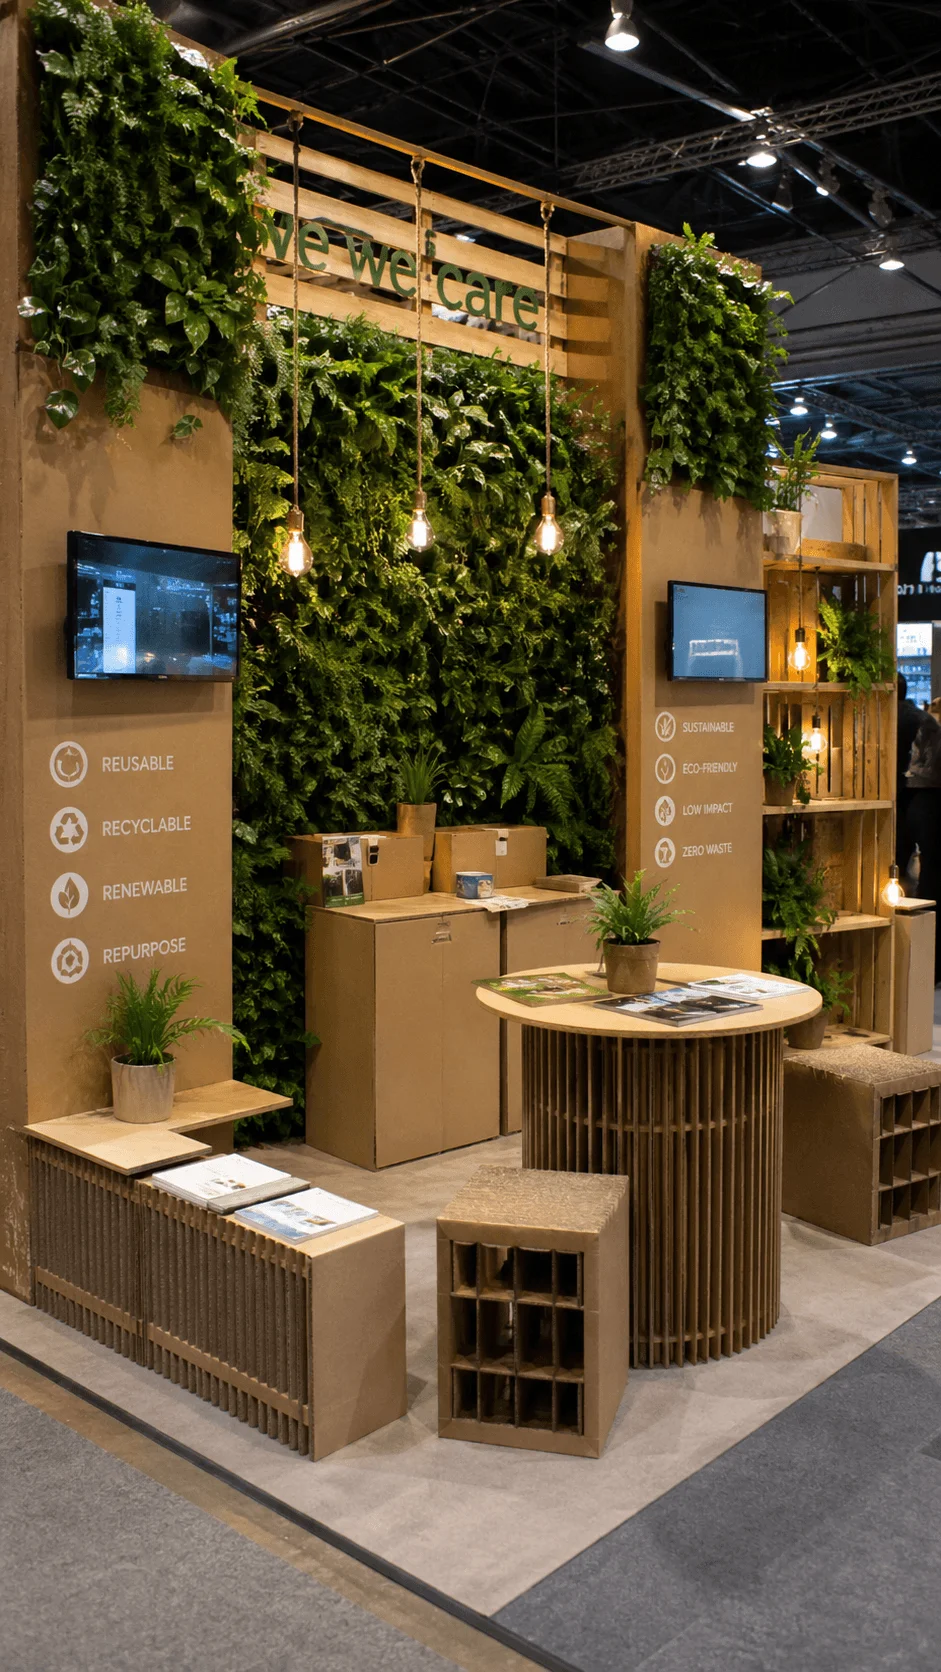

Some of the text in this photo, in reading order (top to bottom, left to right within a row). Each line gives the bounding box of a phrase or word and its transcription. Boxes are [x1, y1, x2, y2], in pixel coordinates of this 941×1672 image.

[345, 234, 417, 297] we
[437, 263, 540, 331] care
[682, 721, 735, 734] SUSTAINABLE
[102, 755, 174, 773] REUSABLE
[682, 761, 738, 775] ECO-FRIENDLY
[682, 802, 733, 816] LOW IMPACT
[102, 815, 192, 837] RECYCLABLE
[682, 842, 733, 858] ZERO WASTE
[102, 877, 188, 901] RENEWABLE
[103, 936, 187, 964] REPURPOSE
